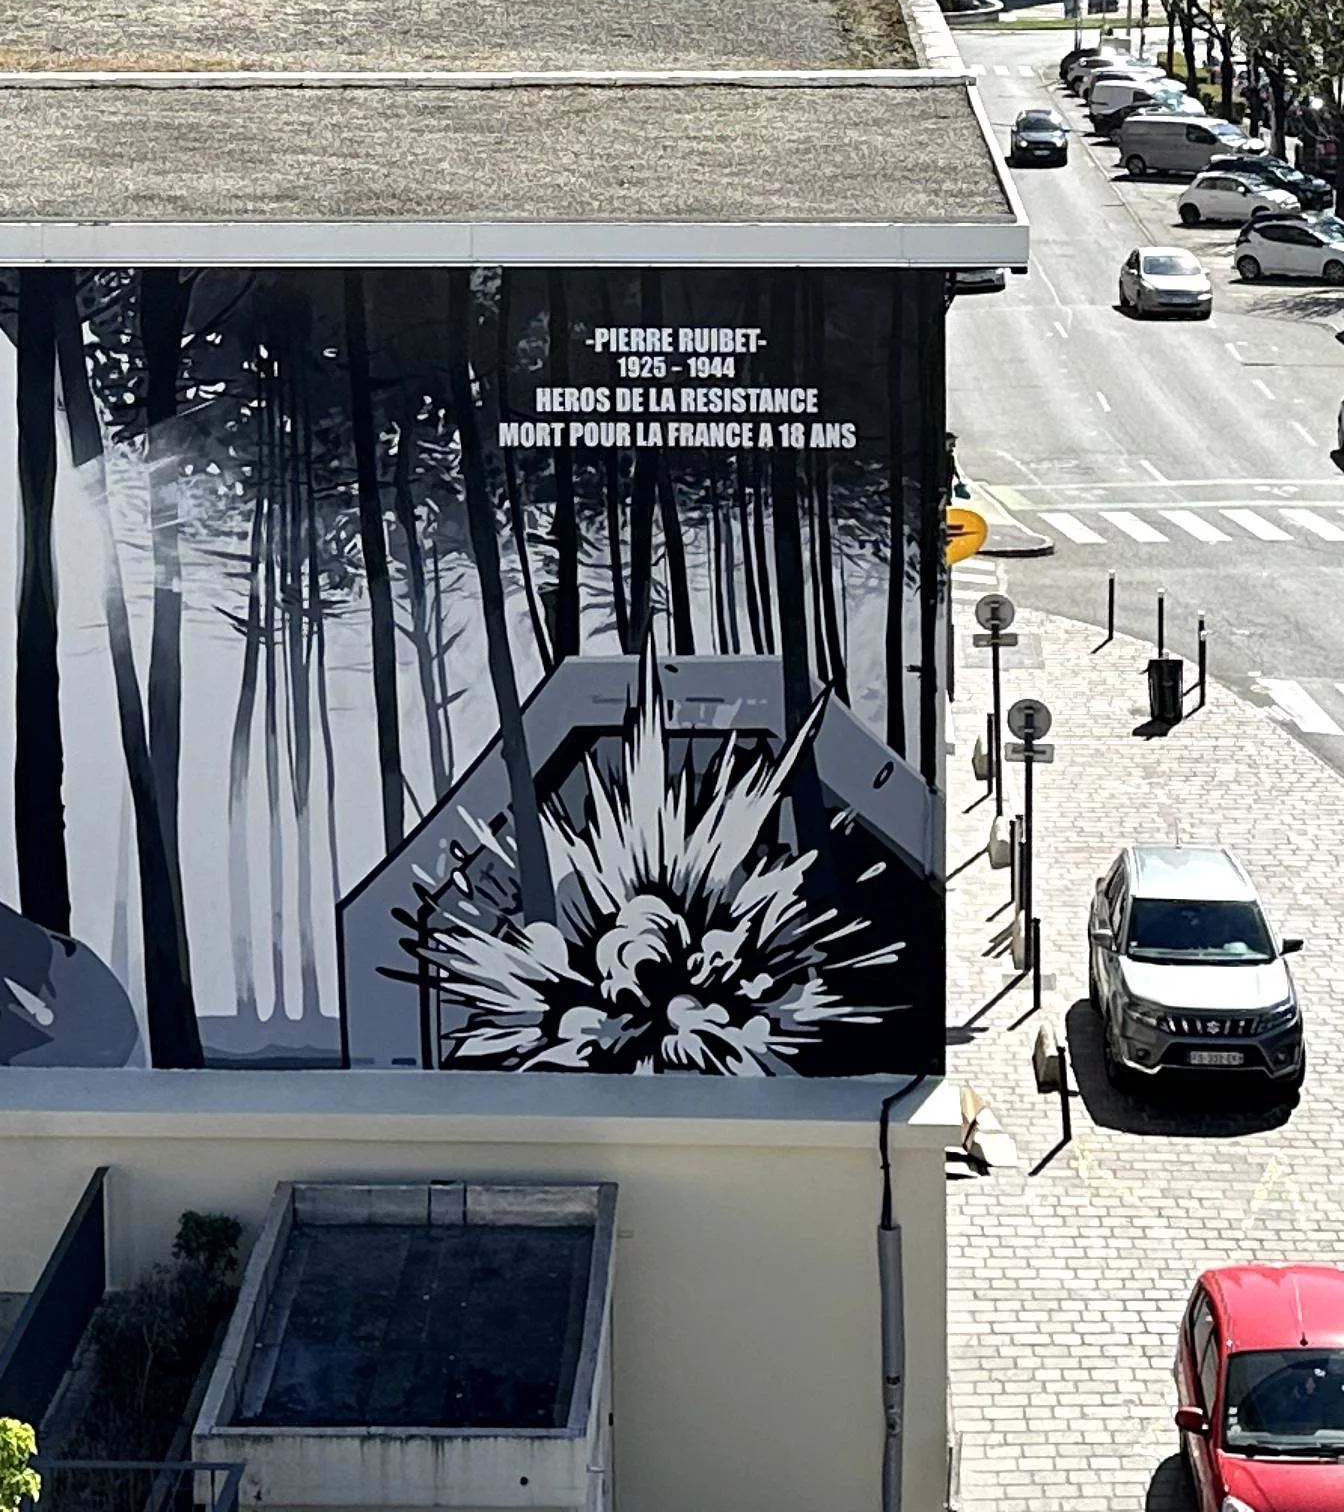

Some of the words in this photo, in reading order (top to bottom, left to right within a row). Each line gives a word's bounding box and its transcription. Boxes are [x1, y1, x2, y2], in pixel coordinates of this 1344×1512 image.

[617, 356, 667, 378] 1925
[686, 356, 736, 378] 1944
[535, 387, 611, 413] HEROS
[615, 387, 644, 413] DE
[648, 387, 676, 413] LA
[680, 387, 819, 414] RESISTANCE
[498, 422, 566, 448] MORT
[569, 422, 631, 448] POUR
[636, 422, 664, 448] LA
[667, 422, 754, 448] FRANCE
[757, 422, 774, 448] A
[778, 422, 805, 449] 18
[809, 422, 857, 449] ANS
